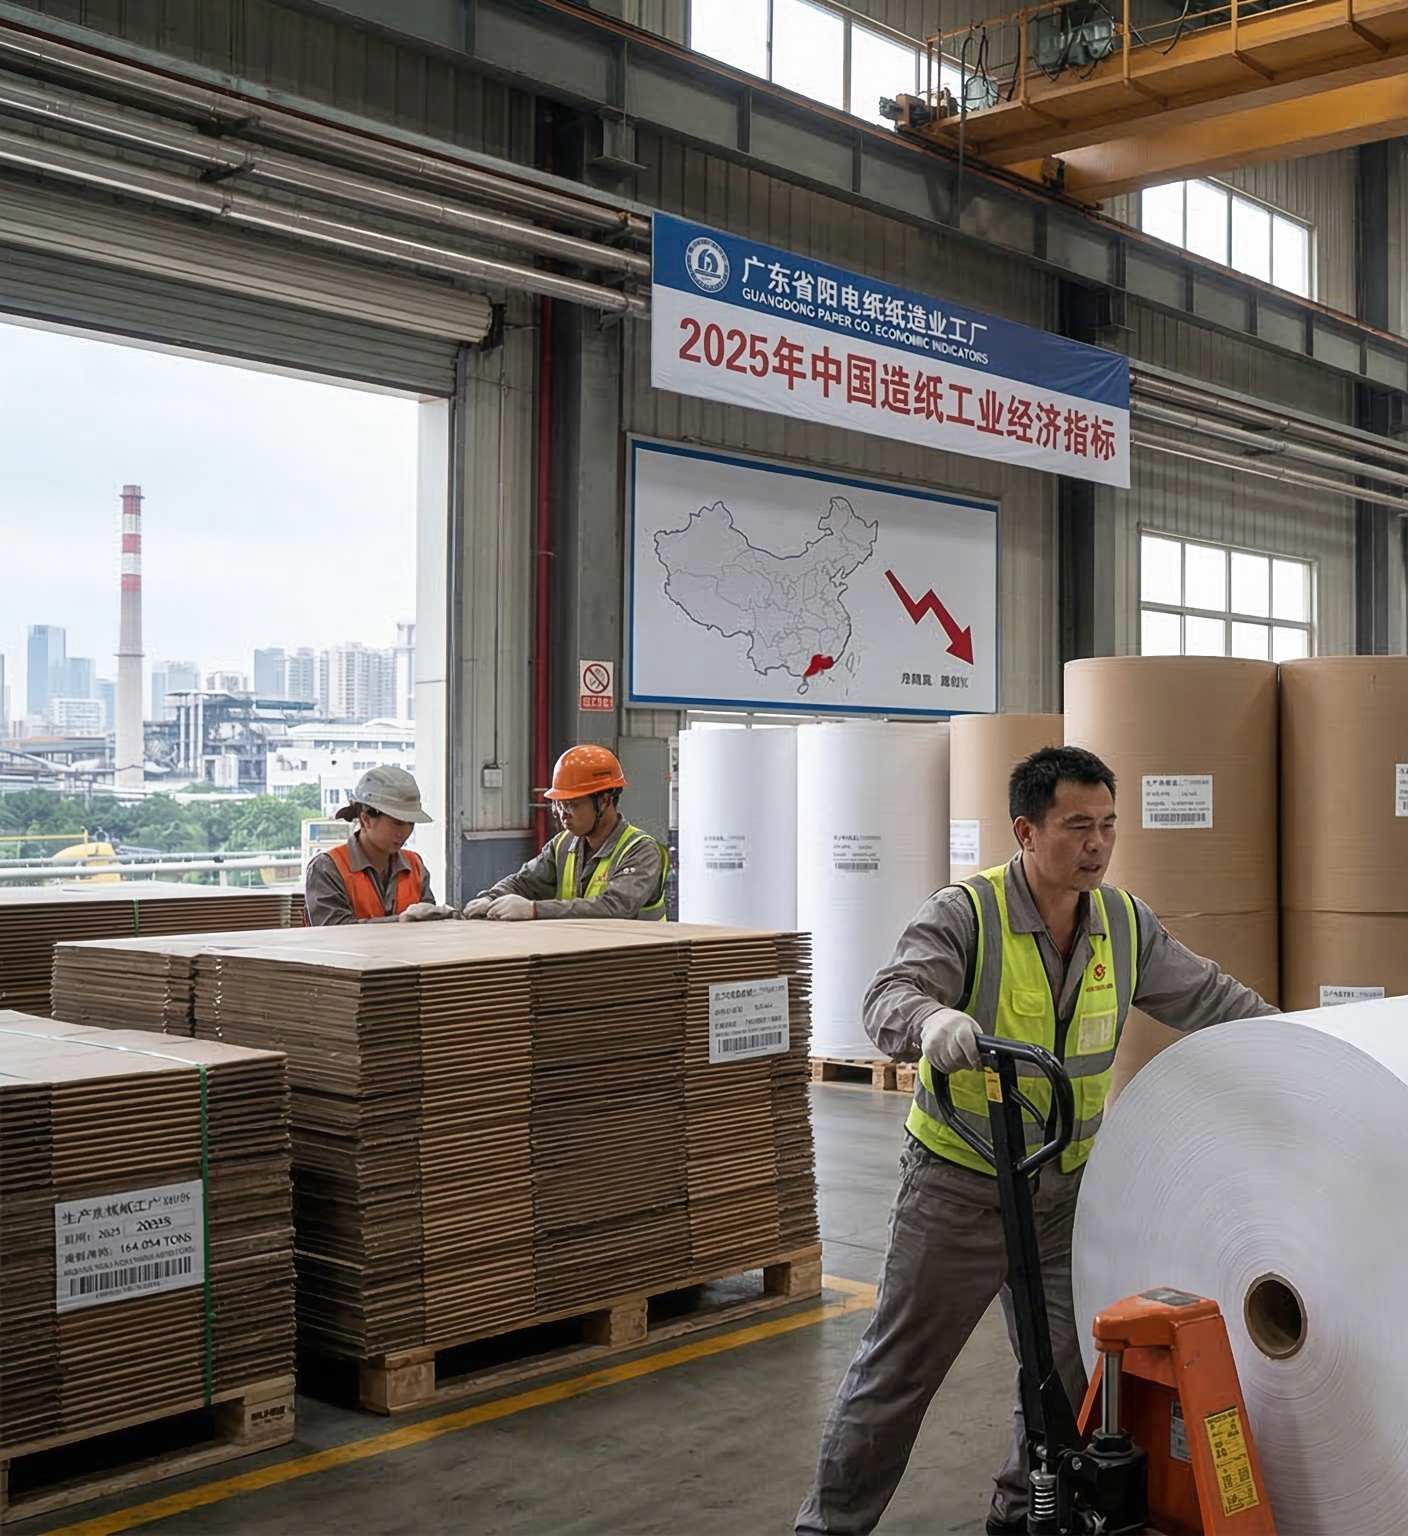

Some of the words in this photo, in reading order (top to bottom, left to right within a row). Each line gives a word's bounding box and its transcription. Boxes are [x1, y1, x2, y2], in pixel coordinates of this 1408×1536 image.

[742, 287, 815, 317] GUANGDONG
[817, 309, 852, 329] PAPER
[854, 319, 873, 335] CO.
[932, 340, 989, 365] INDICATORS
[678, 317, 1116, 461] 2025年中国造纸工业经济指标
[163, 1232, 193, 1247] TONS
